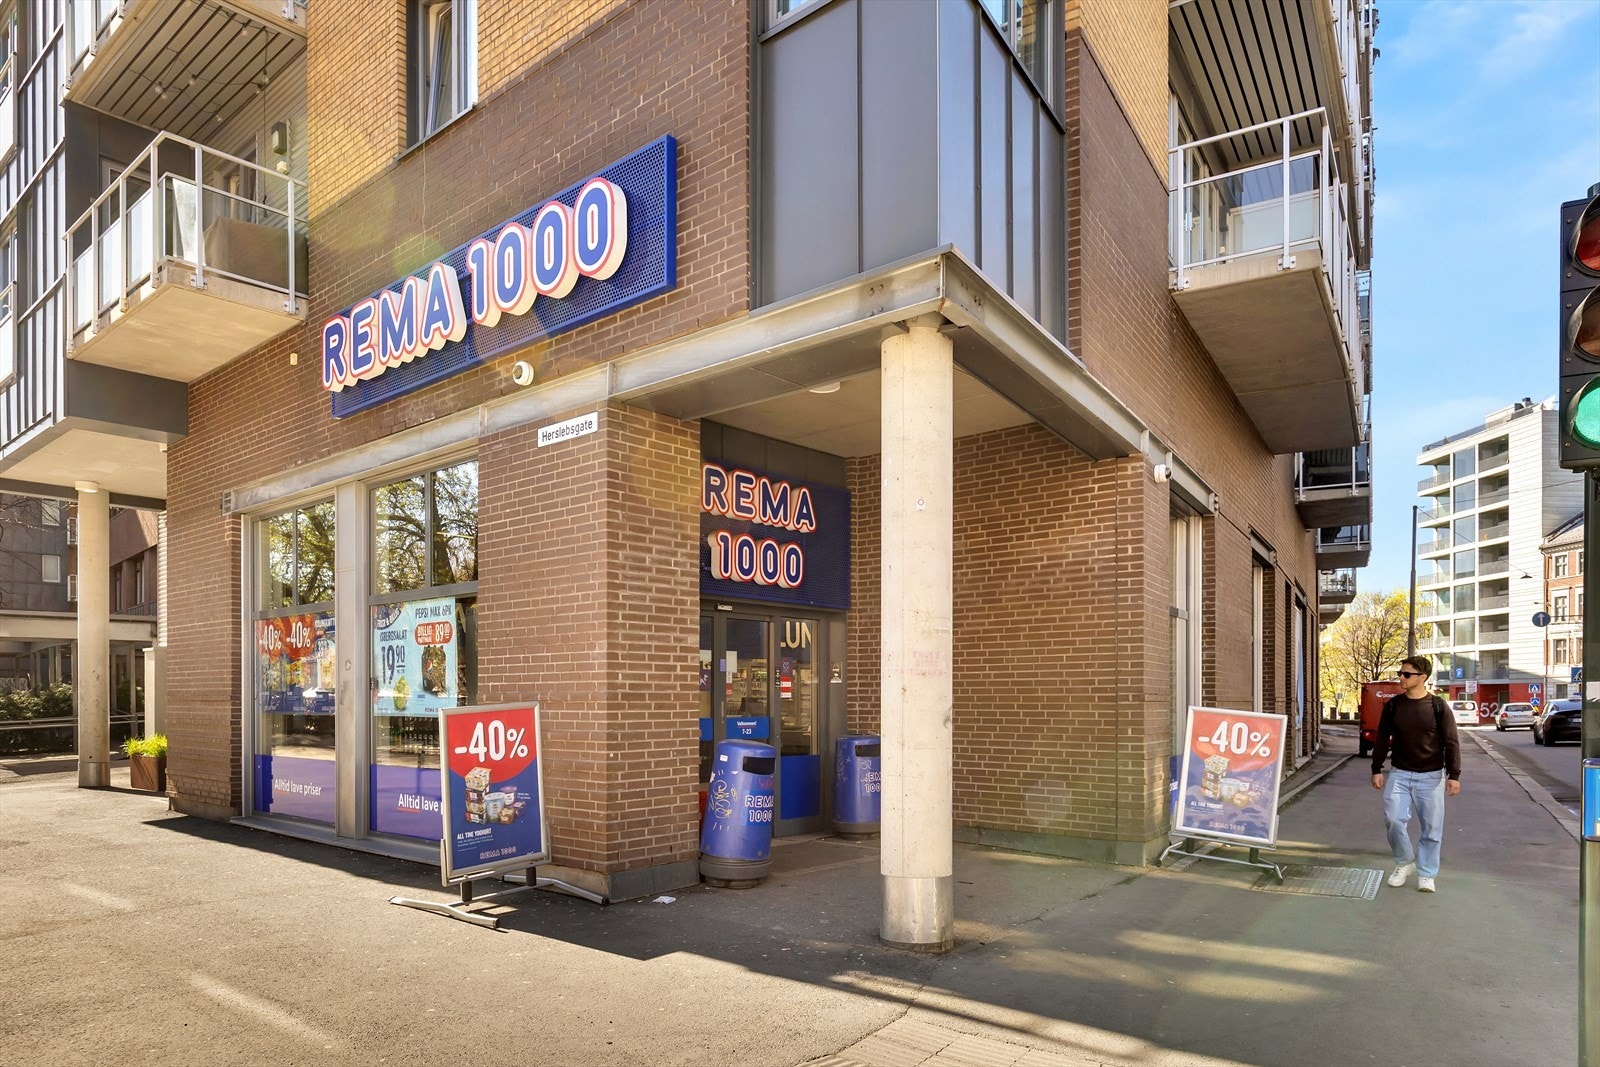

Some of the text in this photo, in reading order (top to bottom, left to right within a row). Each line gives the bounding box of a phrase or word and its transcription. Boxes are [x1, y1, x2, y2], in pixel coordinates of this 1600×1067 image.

[322, 177, 626, 392] REMA 1000
[541, 419, 593, 442] Herslebsgate
[701, 462, 816, 533] REMA
[710, 530, 804, 588] 1000
[415, 607, 429, 619] PEPSI
[430, 605, 441, 617] MAX
[260, 624, 282, 651] -40%
[286, 621, 311, 648] -40%
[435, 623, 444, 643] 89
[381, 644, 405, 685] 19 90
[1480, 702, 1499, 718] 52
[454, 720, 528, 762] -40%
[1198, 721, 1271, 758] -40%
[274, 778, 321, 797] Alltid lave priser
[398, 793, 420, 810] Alltid
[421, 796, 438, 812] lave
